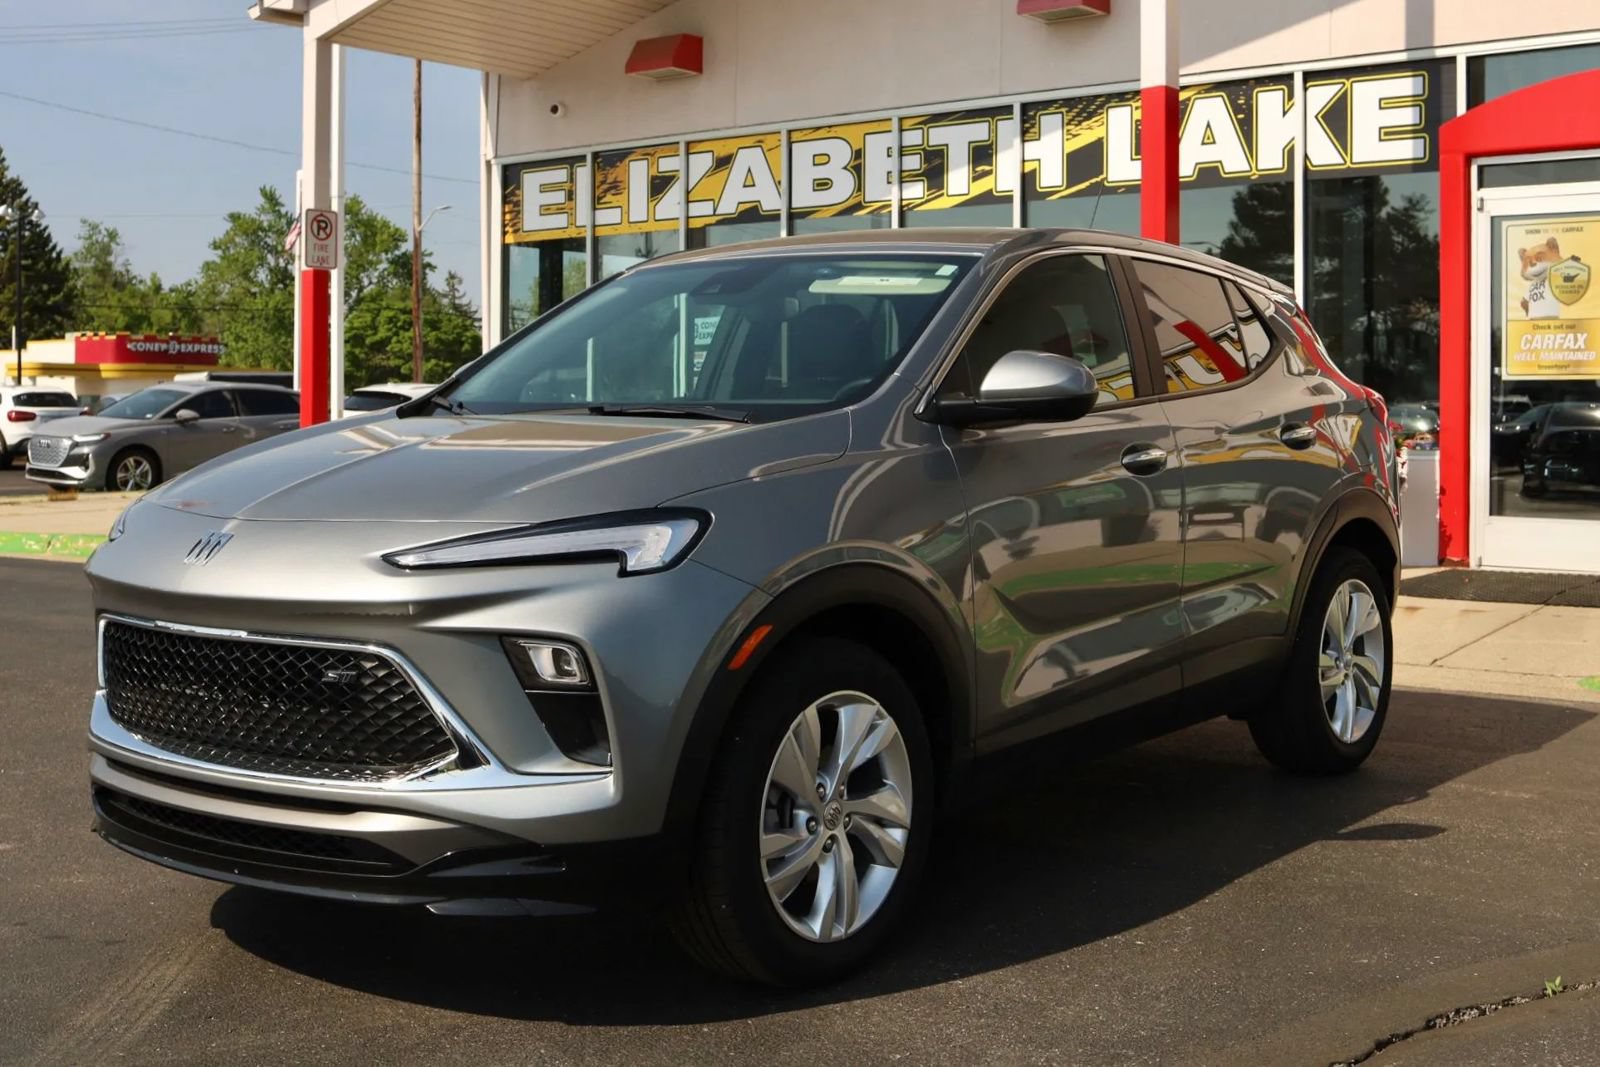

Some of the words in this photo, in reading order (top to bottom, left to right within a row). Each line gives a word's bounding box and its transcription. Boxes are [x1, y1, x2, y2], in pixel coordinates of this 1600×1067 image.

[519, 109, 1067, 233] ELIZABETH
[1104, 71, 1429, 186] LAKE
[313, 243, 329, 253] FIRE
[312, 255, 330, 265] LANE
[1529, 279, 1546, 293] CAR
[1529, 290, 1546, 302] FOX
[1520, 332, 1588, 350] CARFAX
[130, 342, 168, 352] CONEY
[180, 343, 226, 354] EXPRESS
[1513, 352, 1537, 361] WELL
[1539, 351, 1597, 361] MAINTAINED
